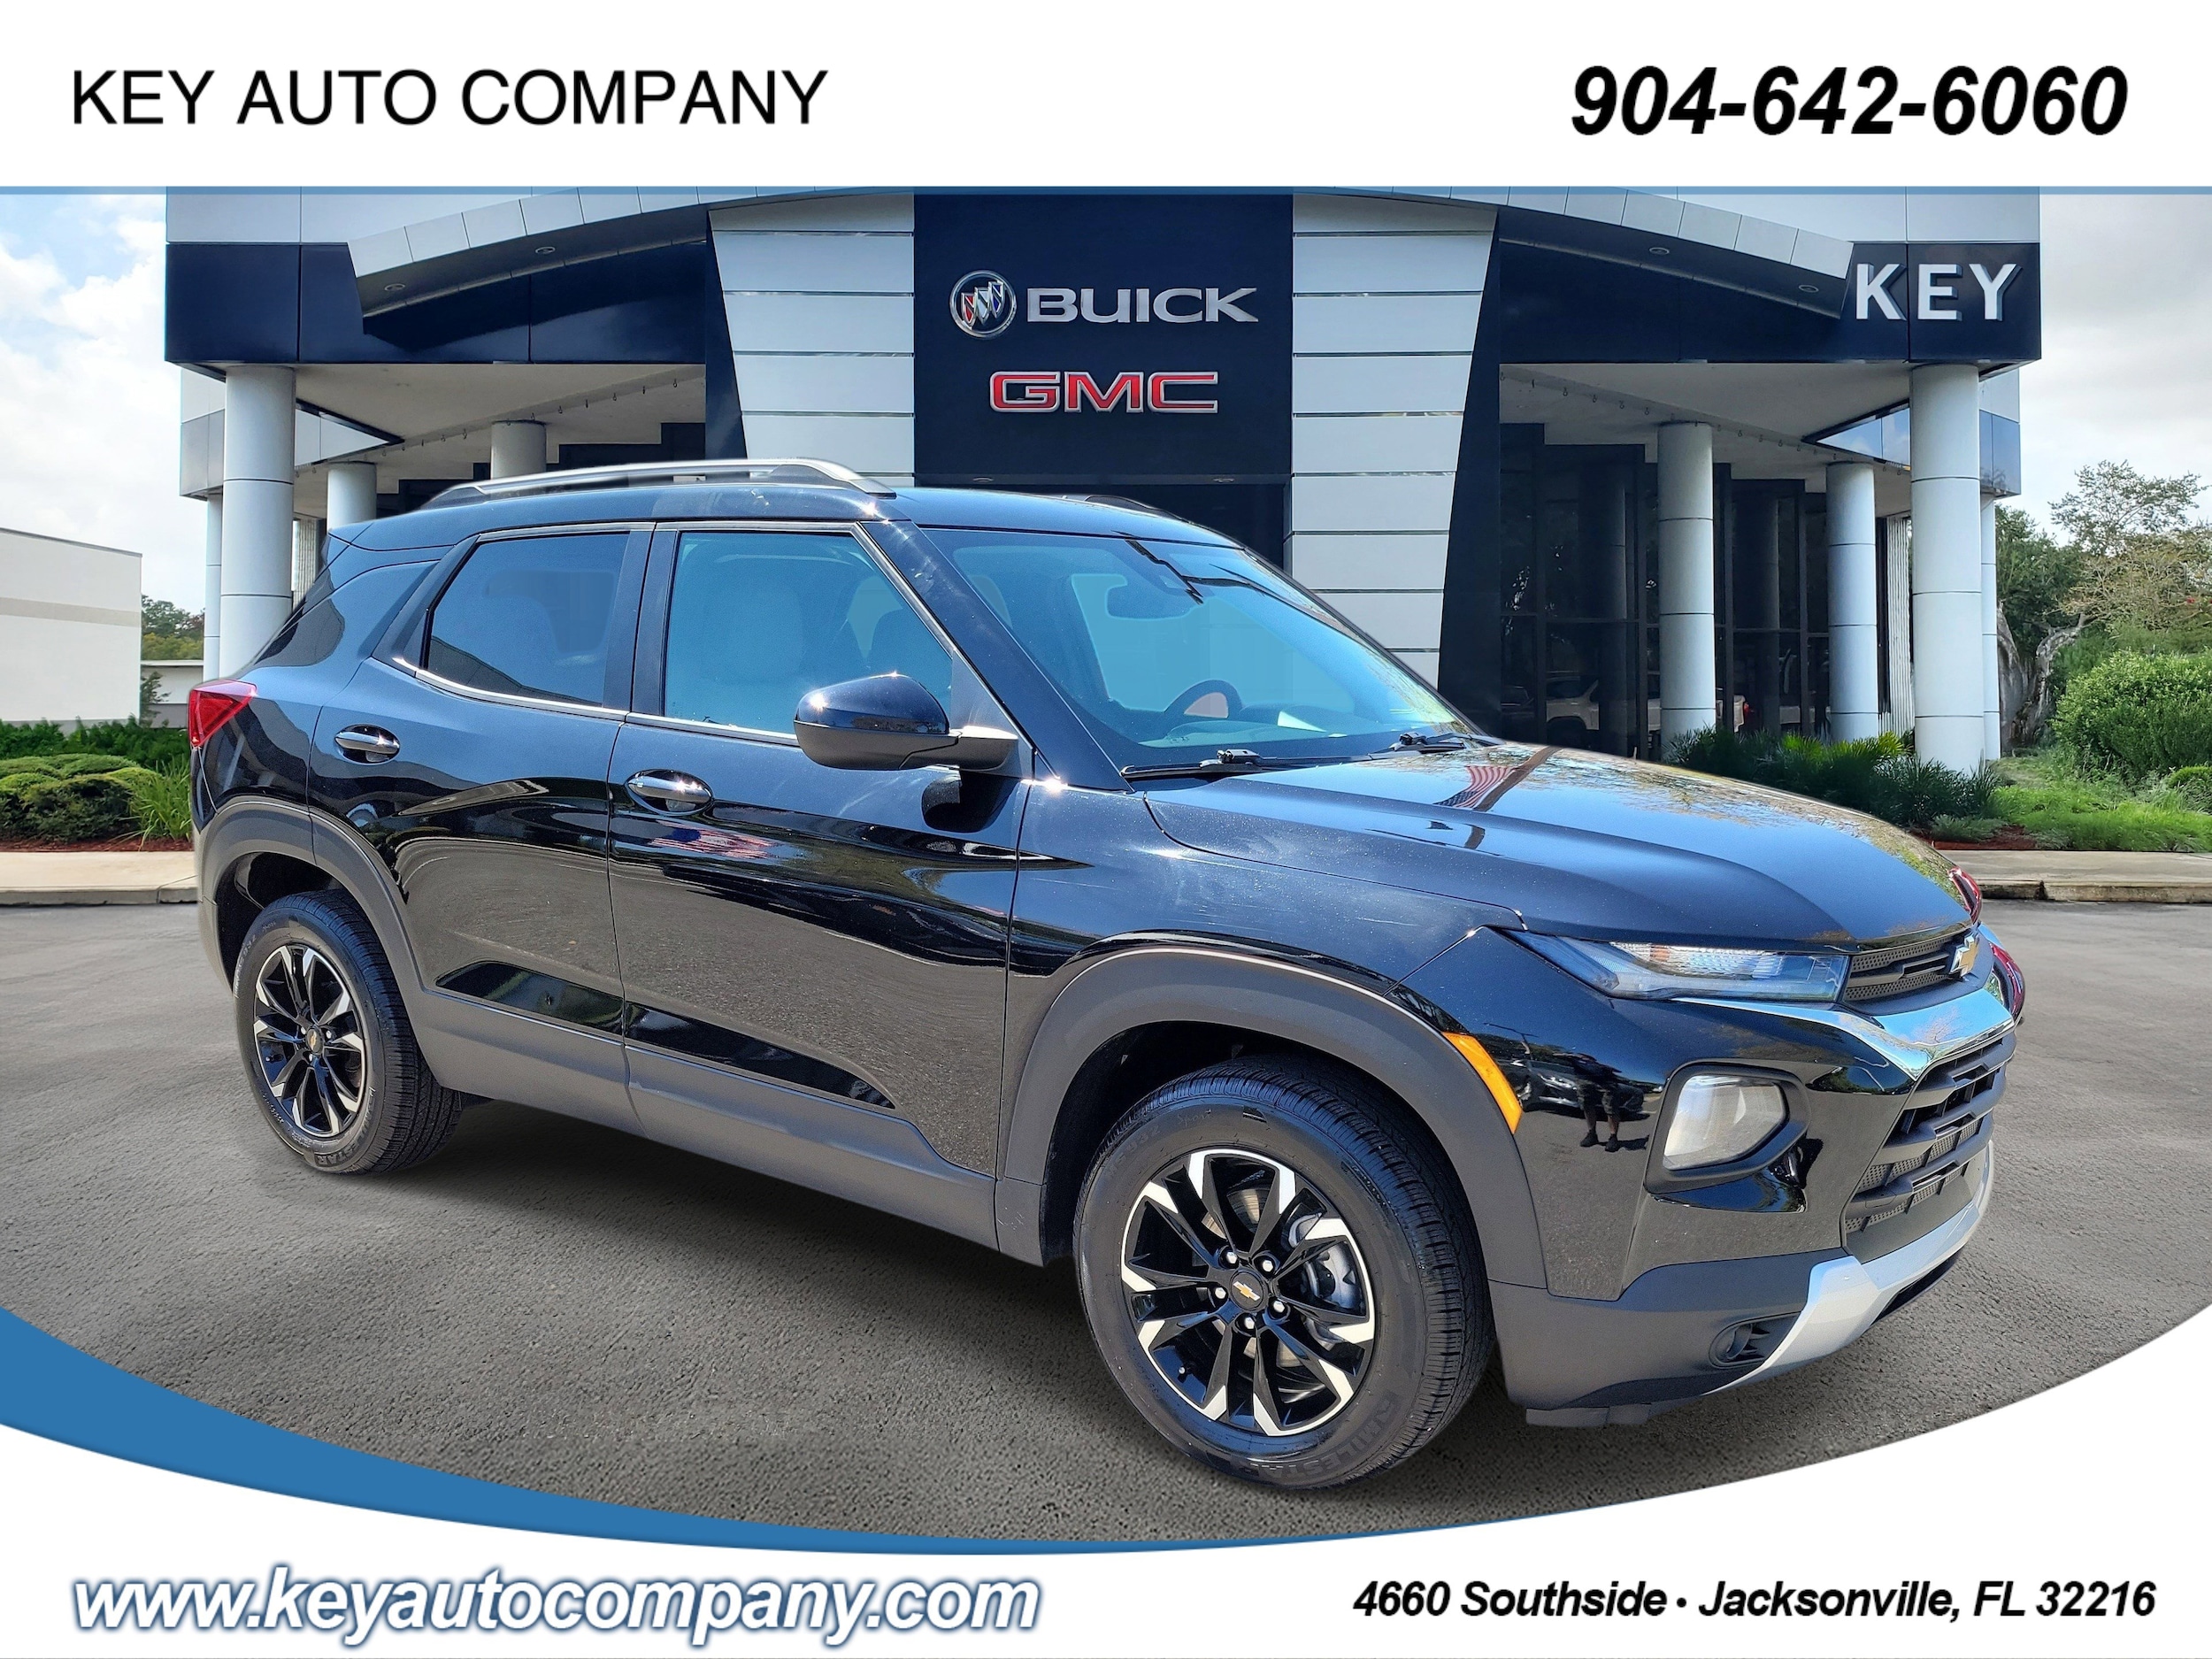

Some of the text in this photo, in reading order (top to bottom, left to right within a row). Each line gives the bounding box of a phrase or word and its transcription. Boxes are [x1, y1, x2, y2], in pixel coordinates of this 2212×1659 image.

[1026, 287, 1259, 324] BUICK
[1855, 263, 2023, 322] KEY
[988, 370, 1219, 414] GMC
